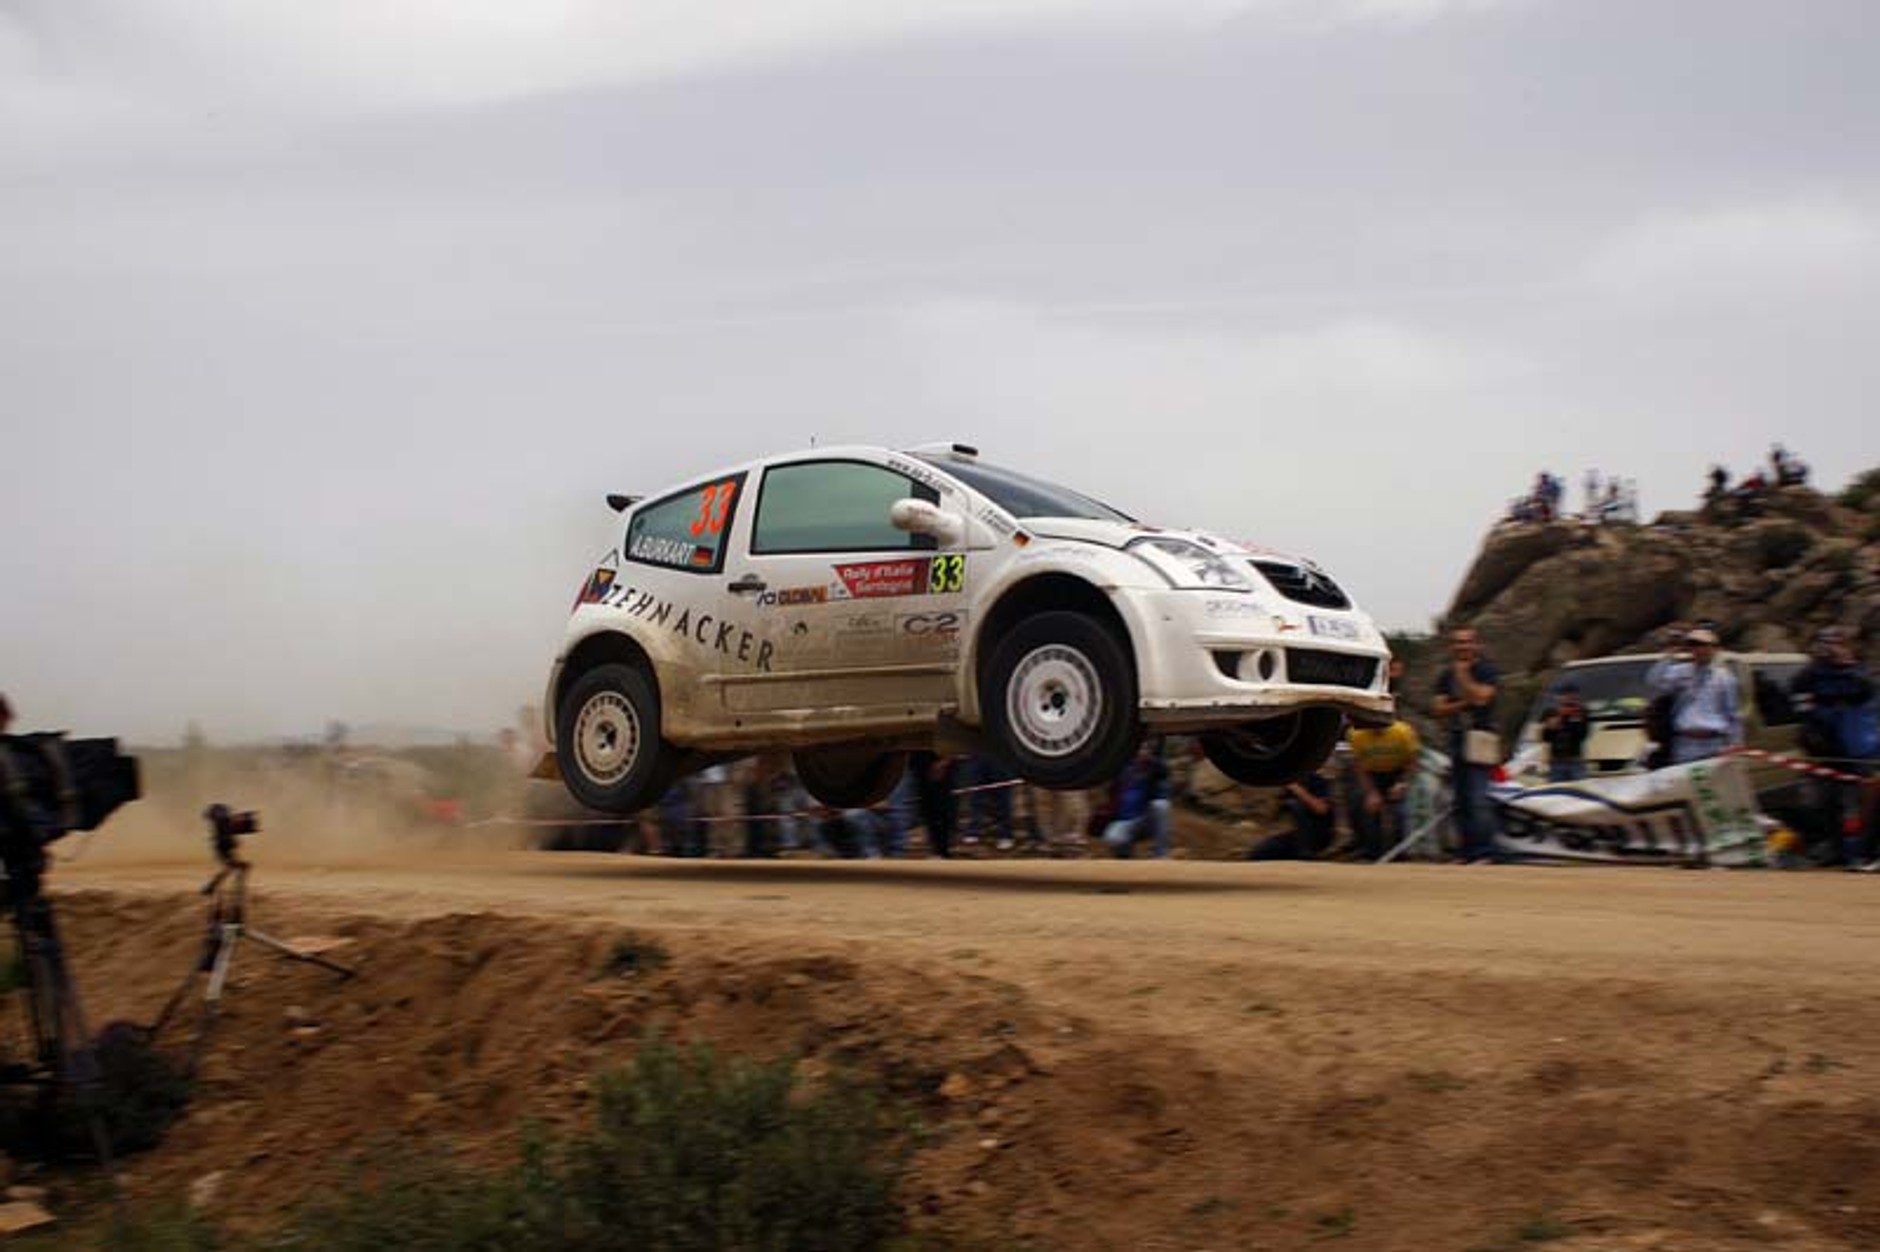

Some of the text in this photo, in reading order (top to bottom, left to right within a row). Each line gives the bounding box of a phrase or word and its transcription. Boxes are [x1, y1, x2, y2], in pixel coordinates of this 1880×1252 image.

[689, 480, 736, 537] 33
[931, 555, 965, 593] 33
[600, 583, 774, 673] ZEHNACKER
[903, 612, 960, 635] C2
